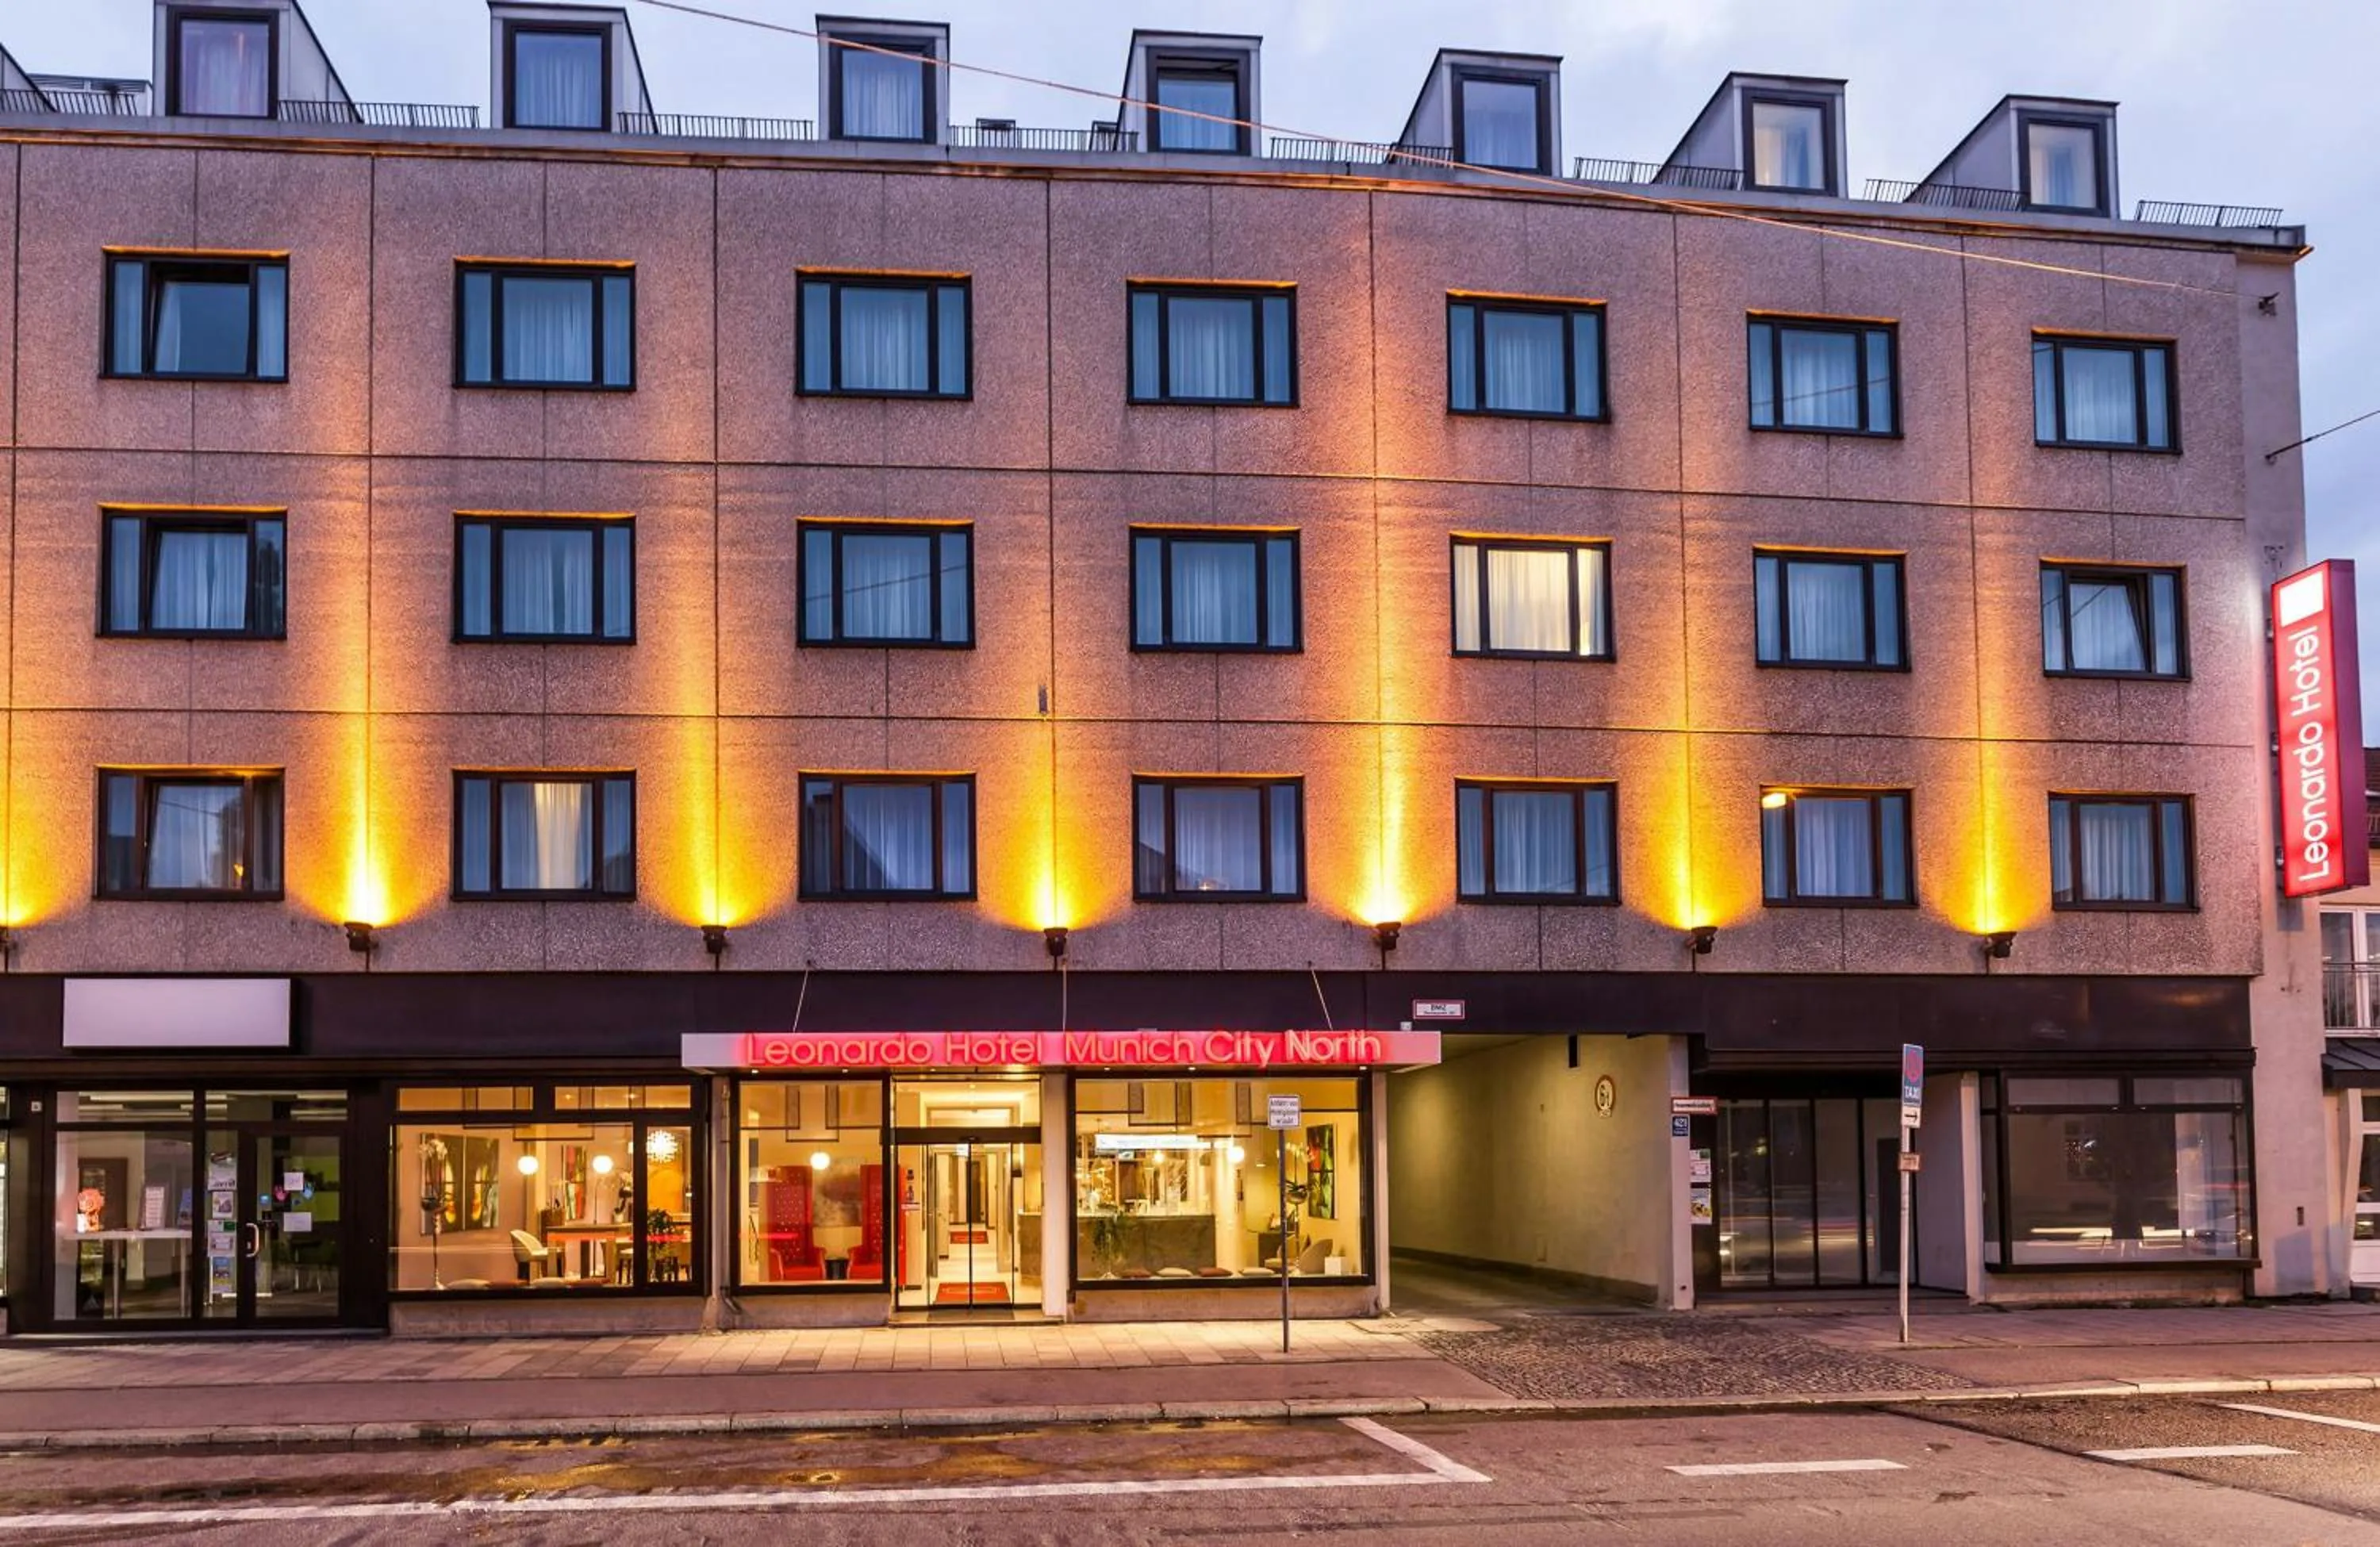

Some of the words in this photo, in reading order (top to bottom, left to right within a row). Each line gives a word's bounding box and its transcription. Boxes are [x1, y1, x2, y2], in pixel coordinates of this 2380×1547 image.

[2288, 625, 2321, 717] Hotel
[2292, 721, 2329, 881] Leonardo
[746, 1034, 933, 1065] Leonardo
[945, 1033, 1043, 1064] Hotel
[1064, 1032, 1196, 1063] Munich
[1204, 1031, 1276, 1068] City
[1285, 1030, 1382, 1062] North
